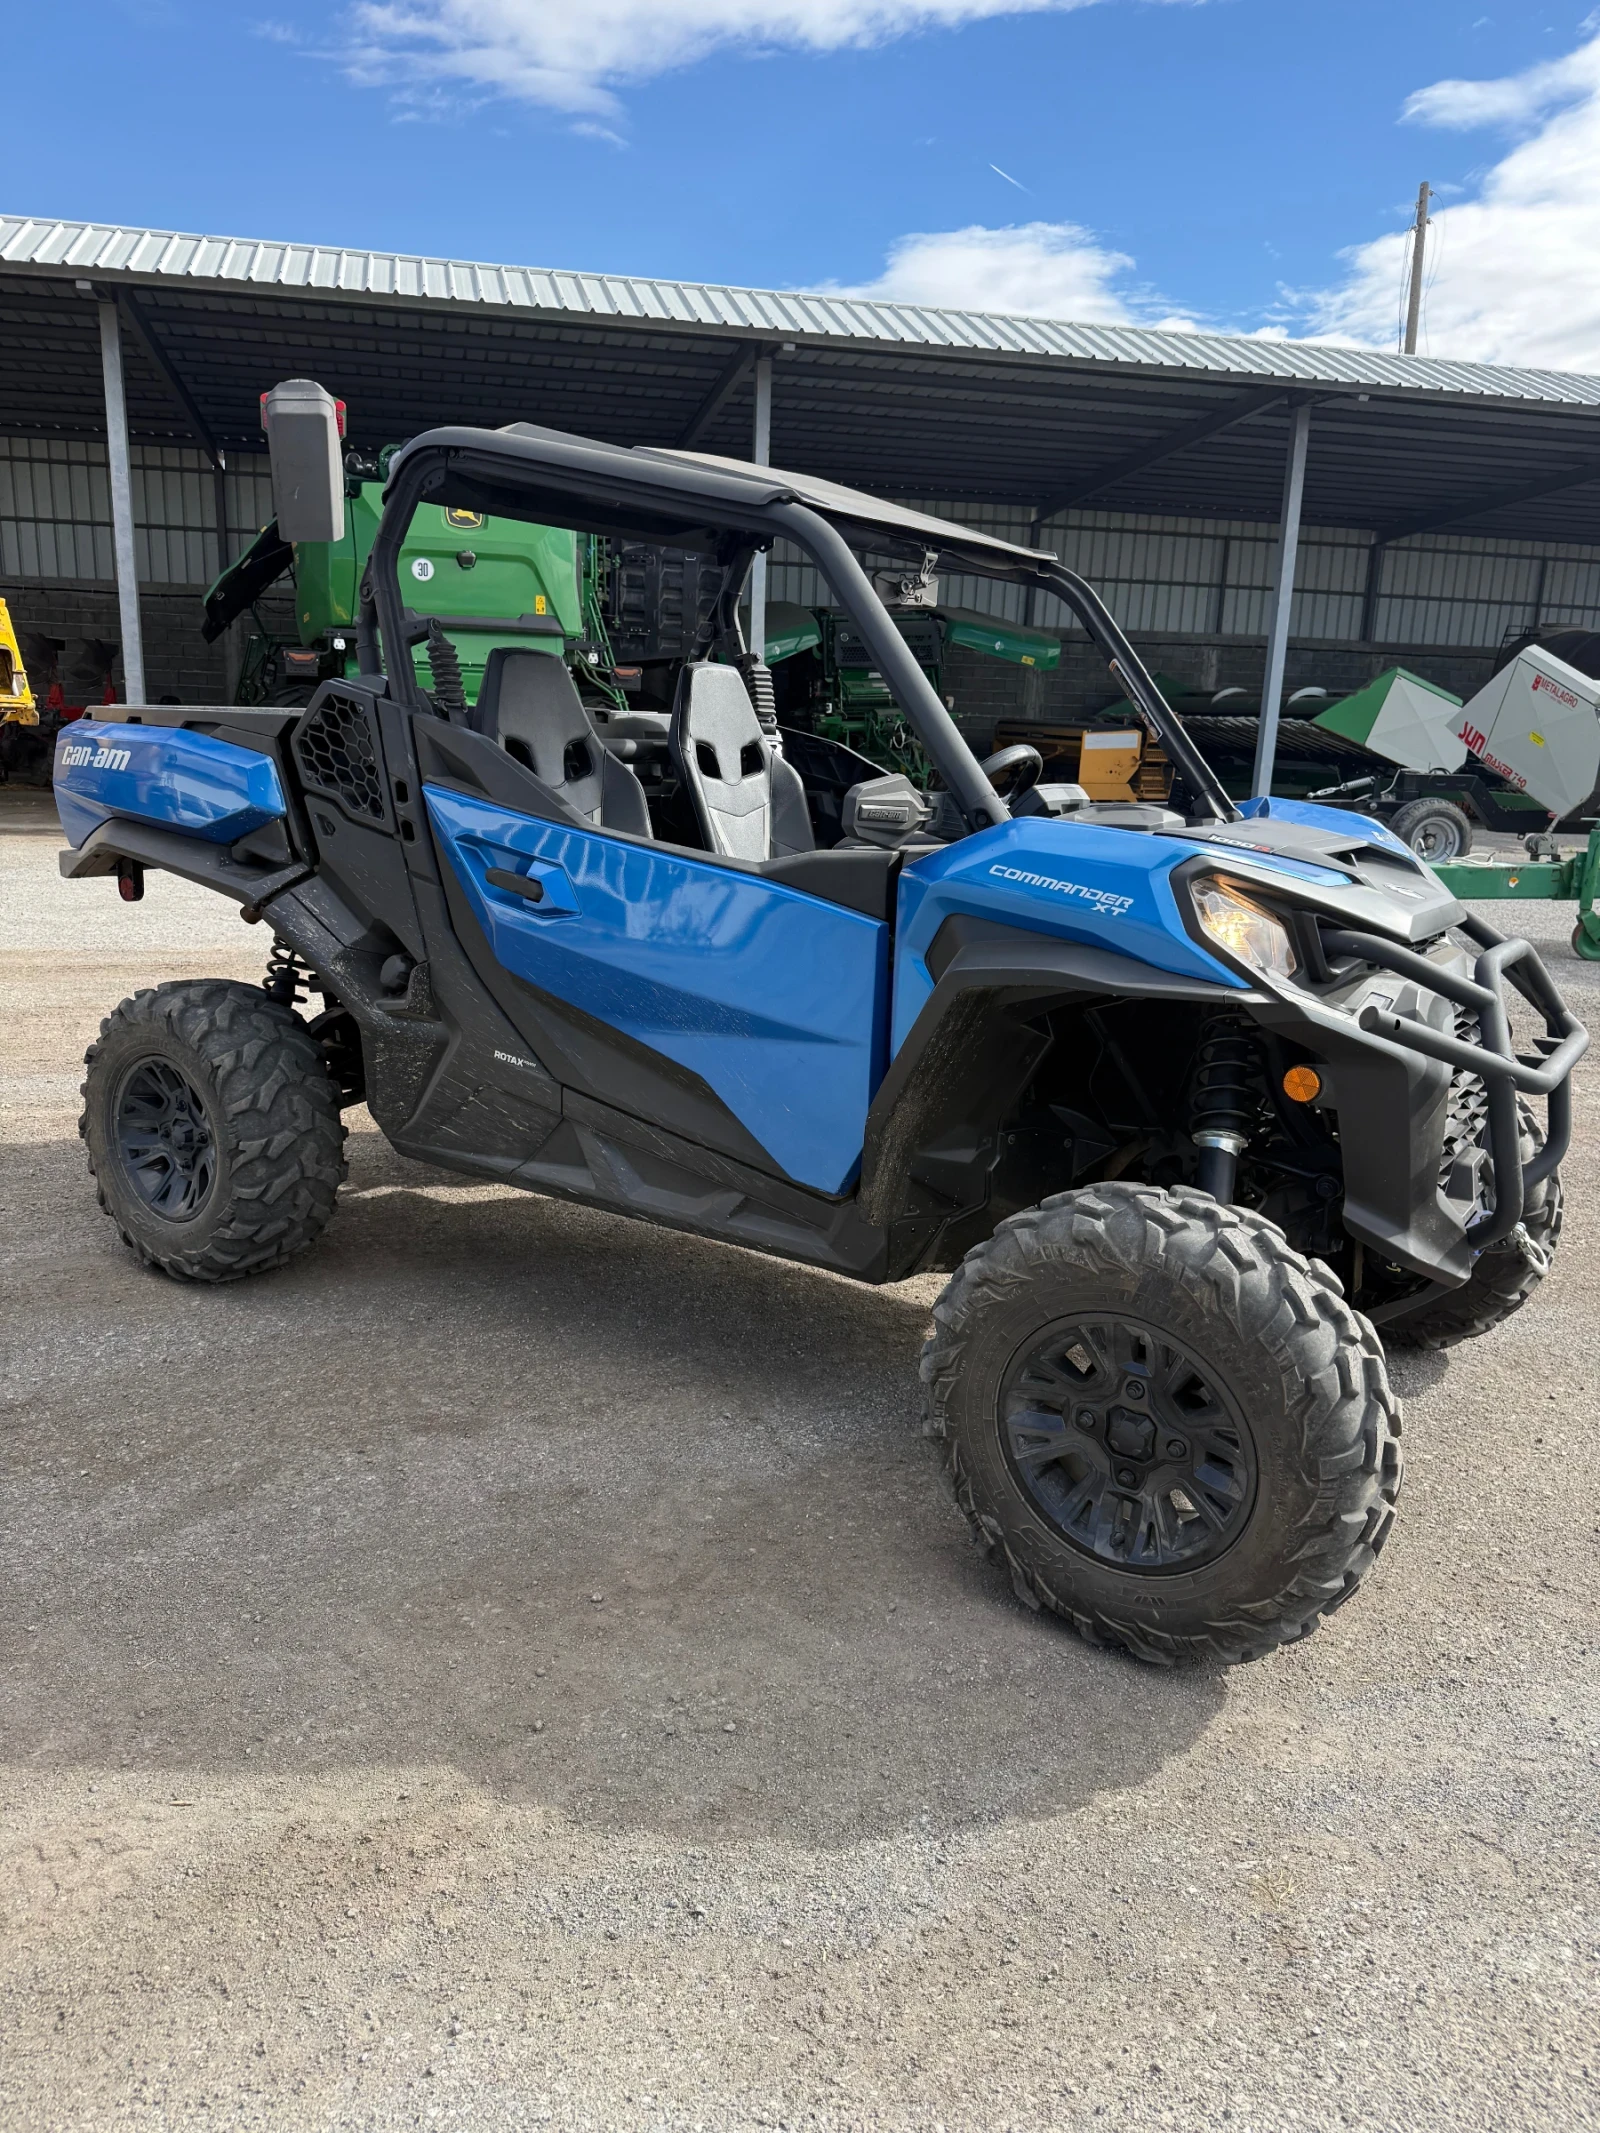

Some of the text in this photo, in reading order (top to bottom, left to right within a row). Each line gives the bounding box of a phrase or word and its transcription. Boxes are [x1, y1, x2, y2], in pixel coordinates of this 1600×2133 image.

[417, 562, 429, 577] 30
[1540, 677, 1579, 708] METALAGRO
[61, 745, 132, 771] can-am
[988, 864, 1135, 909] COMMANDER
[1090, 902, 1127, 916] XT
[494, 1050, 523, 1067] ROTAX
